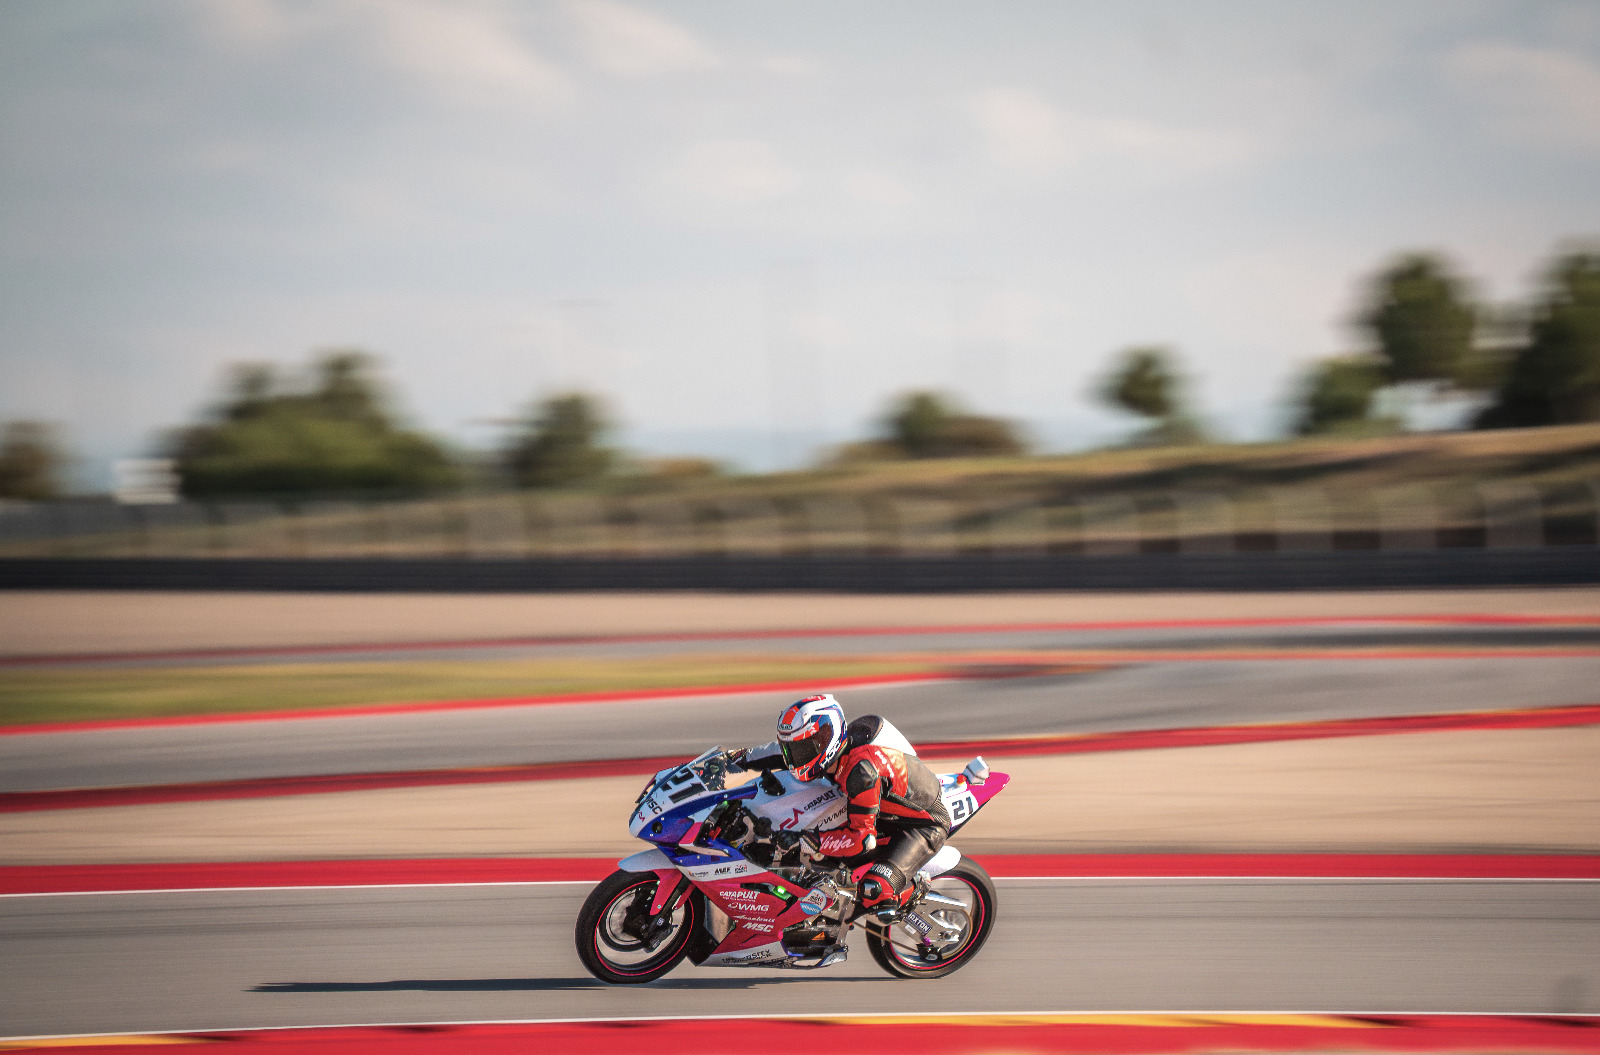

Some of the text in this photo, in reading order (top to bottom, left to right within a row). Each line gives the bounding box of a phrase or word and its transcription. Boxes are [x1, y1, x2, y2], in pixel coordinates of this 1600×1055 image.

[660, 767, 706, 804] 21
[803, 790, 836, 811] CATAPULT
[952, 796, 973, 820] 21
[874, 863, 893, 879] RIDER
[719, 890, 760, 900] CATAPULT
[738, 903, 769, 912] WMG
[742, 922, 774, 932] MSC
[907, 912, 931, 932] AXTON
